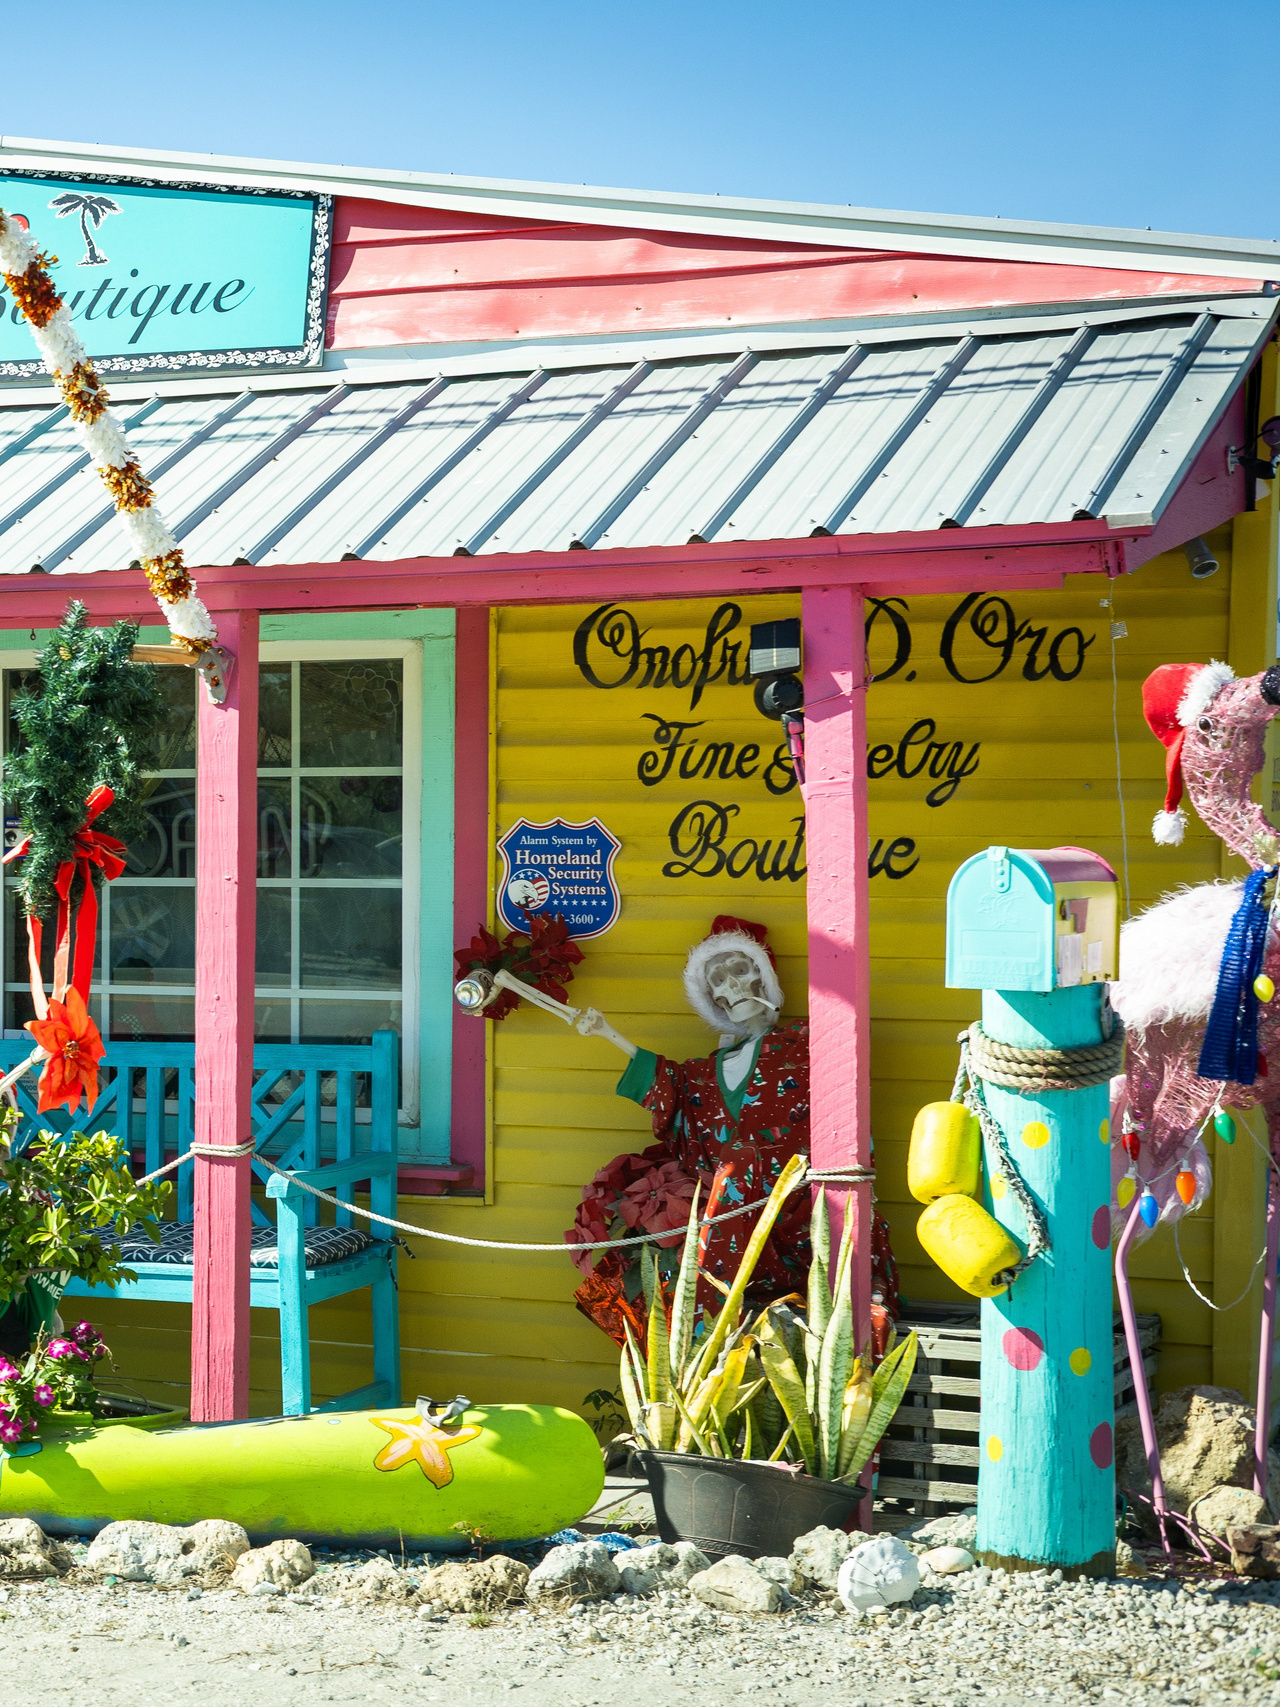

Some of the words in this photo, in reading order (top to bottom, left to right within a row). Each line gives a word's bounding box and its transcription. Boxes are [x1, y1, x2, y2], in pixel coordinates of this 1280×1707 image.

[940, 592, 1097, 684] Oro
[637, 713, 760, 786] Fine
[519, 835, 549, 845] Alarm
[551, 835, 584, 848] System
[586, 835, 598, 848] by
[515, 849, 602, 865] Homeland
[548, 866, 604, 884] Security
[552, 882, 607, 898] Systems
